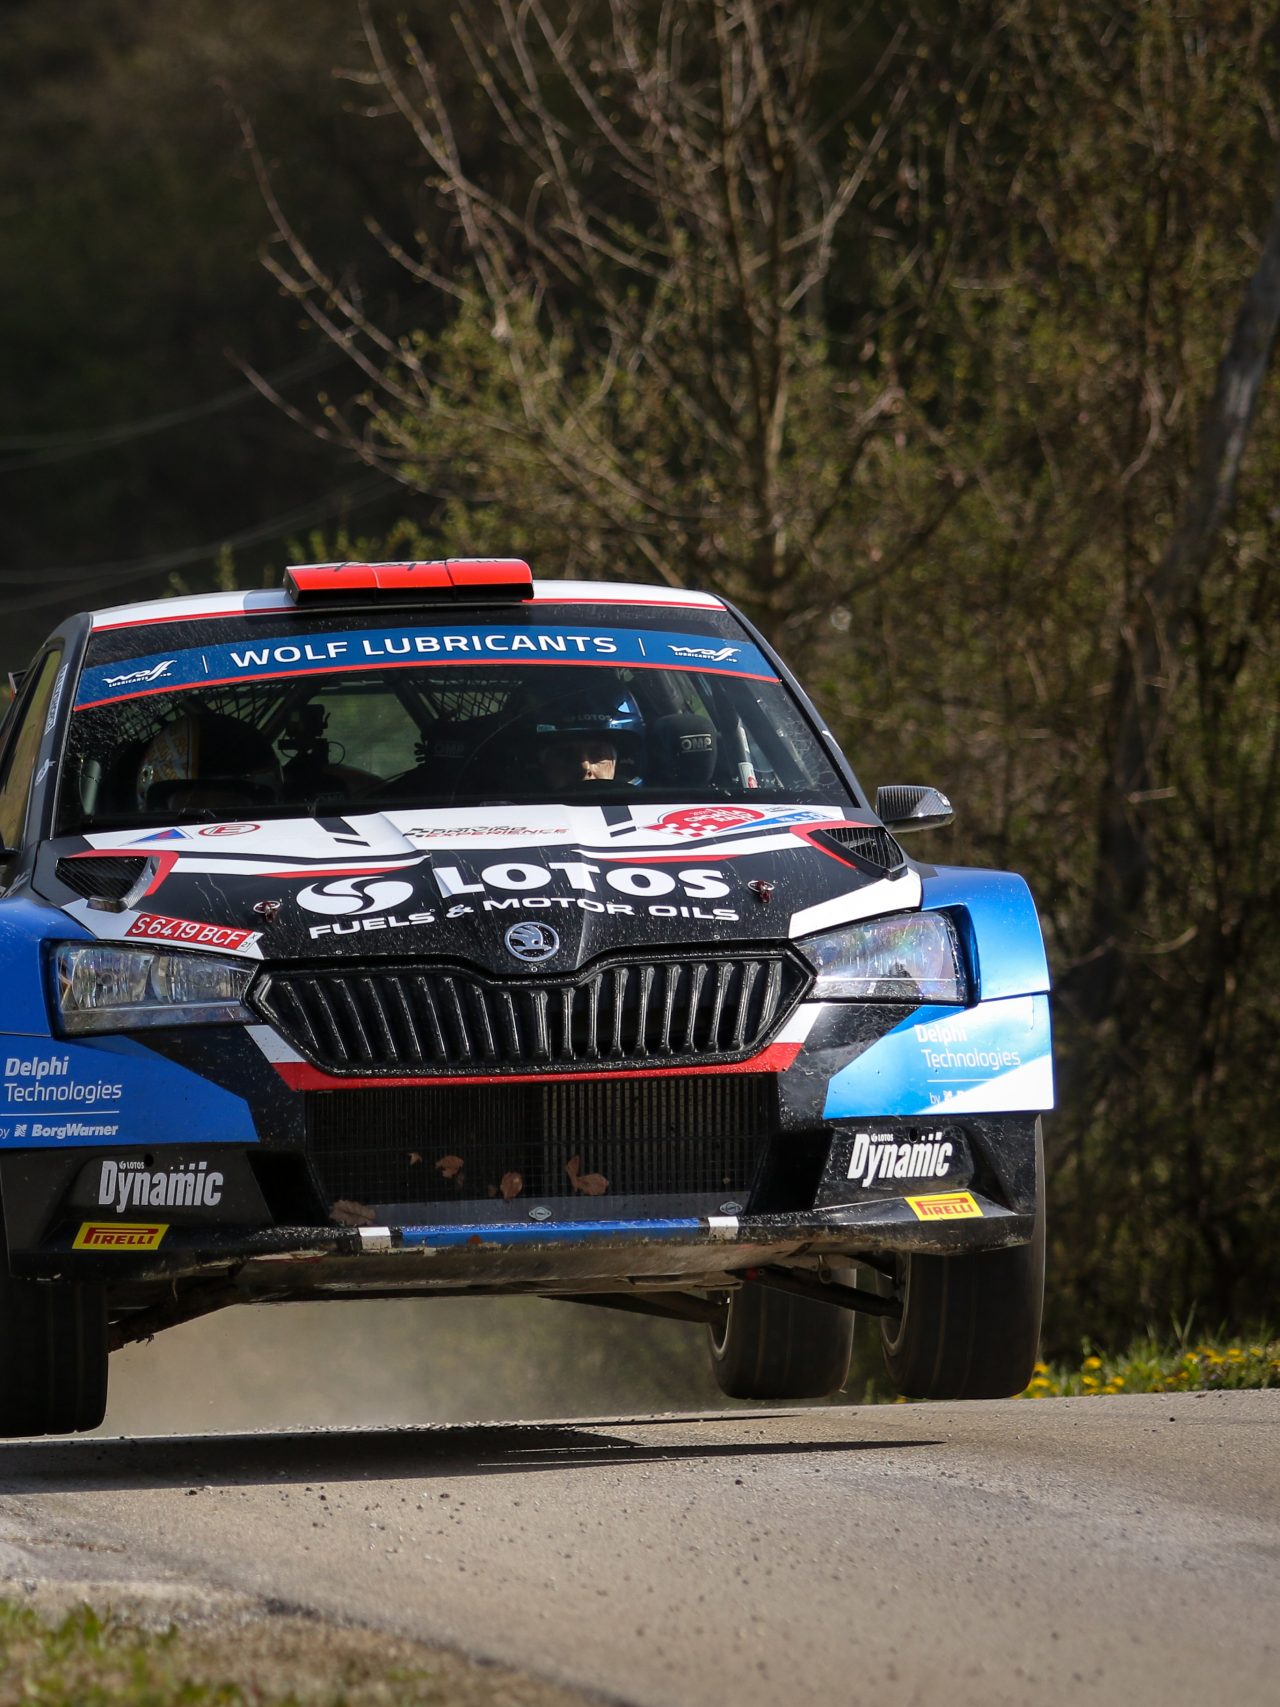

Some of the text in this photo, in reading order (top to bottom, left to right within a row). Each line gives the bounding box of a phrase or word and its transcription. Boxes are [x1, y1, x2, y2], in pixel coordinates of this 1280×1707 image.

[230, 635, 618, 668] WOLF LUBRICANTS
[675, 651, 715, 660] LUBRICANTS
[108, 676, 149, 688] LUBRICANTS
[681, 736, 712, 751] OMP
[432, 862, 730, 899] LOTOS
[309, 897, 740, 940] FUELS & MOTOR OILS
[131, 917, 248, 946] S 6419 BCF
[914, 1024, 968, 1046] Delphi
[4, 1056, 70, 1080] Delphi
[921, 1048, 1021, 1070] Technologies
[4, 1081, 123, 1104] Technologies
[32, 1123, 119, 1142] BorgWarner
[878, 1134, 894, 1142] LOTOS
[127, 1161, 145, 1170] LOTOS
[847, 1132, 953, 1188] Dynamic
[98, 1161, 223, 1212] Dynamic
[915, 1197, 974, 1216] PIRELLI
[82, 1227, 160, 1245] PIRELLI
